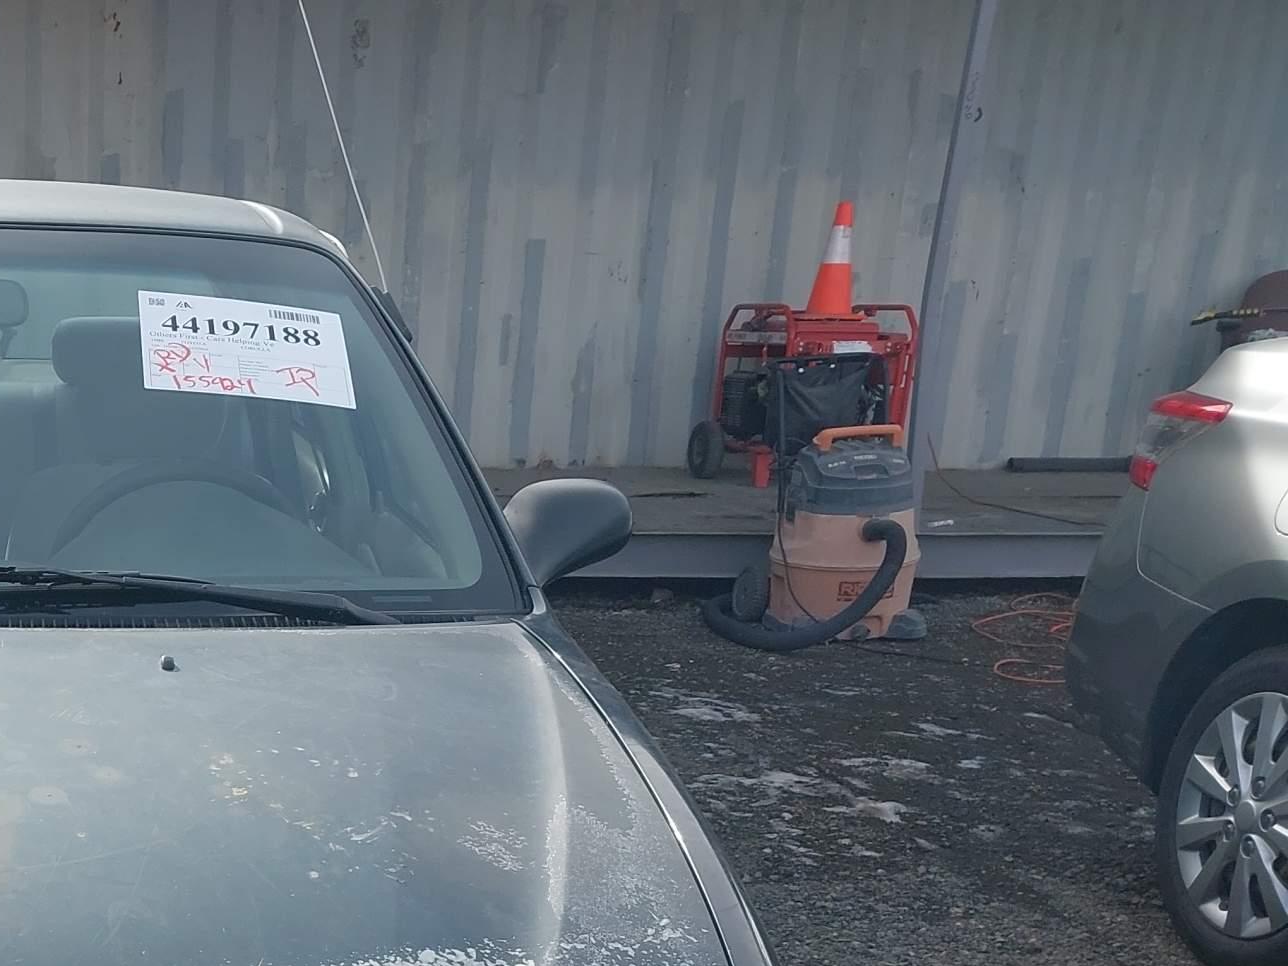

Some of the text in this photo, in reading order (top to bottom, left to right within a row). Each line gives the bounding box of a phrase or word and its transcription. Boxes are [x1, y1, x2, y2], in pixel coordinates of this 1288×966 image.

[161, 314, 321, 347] 44197188
[206, 334, 226, 343] Cars
[228, 336, 260, 347] Helping
